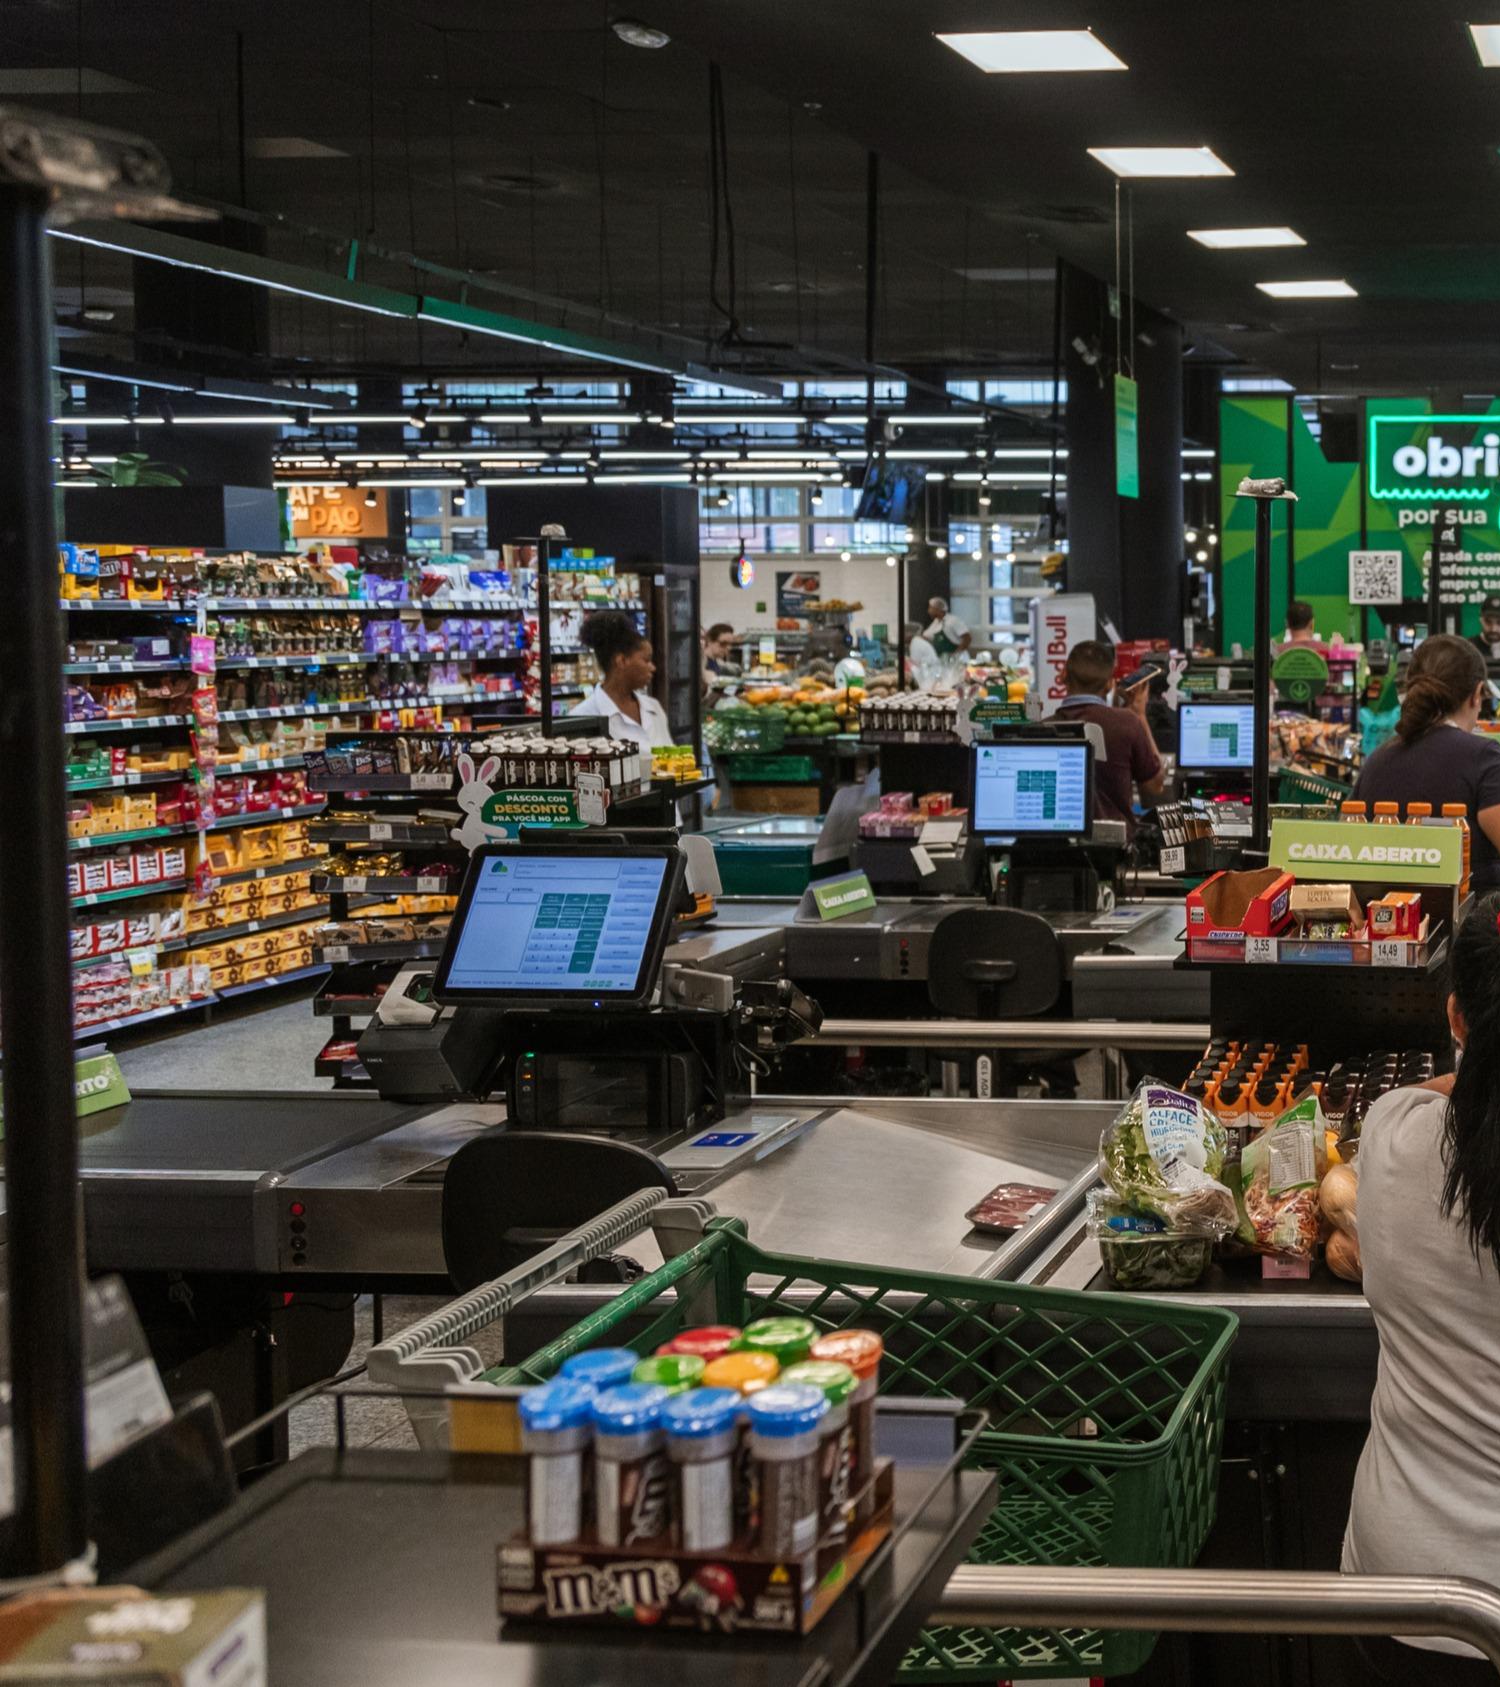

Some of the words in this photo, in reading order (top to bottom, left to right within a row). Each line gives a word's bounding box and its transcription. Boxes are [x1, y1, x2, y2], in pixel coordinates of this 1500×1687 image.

[1399, 509, 1437, 527] por
[1444, 510, 1488, 524] sua
[1440, 550, 1473, 562] cada
[1422, 578, 1479, 592] Cmpre
[1046, 616, 1067, 655] Bull
[1047, 659, 1068, 700] Red
[506, 793, 545, 803] PÁSCOA
[547, 795, 568, 803] COM
[494, 804, 569, 814] DESCONTO
[513, 814, 536, 822] VOCÊ
[553, 815, 571, 823] APP
[1288, 843, 1352, 860] CAIXA
[1357, 846, 1442, 864] ABERTO
[1254, 940, 1270, 951] 3,55
[1378, 944, 1398, 957] 14,49
[75, 1075, 109, 1096] RTO
